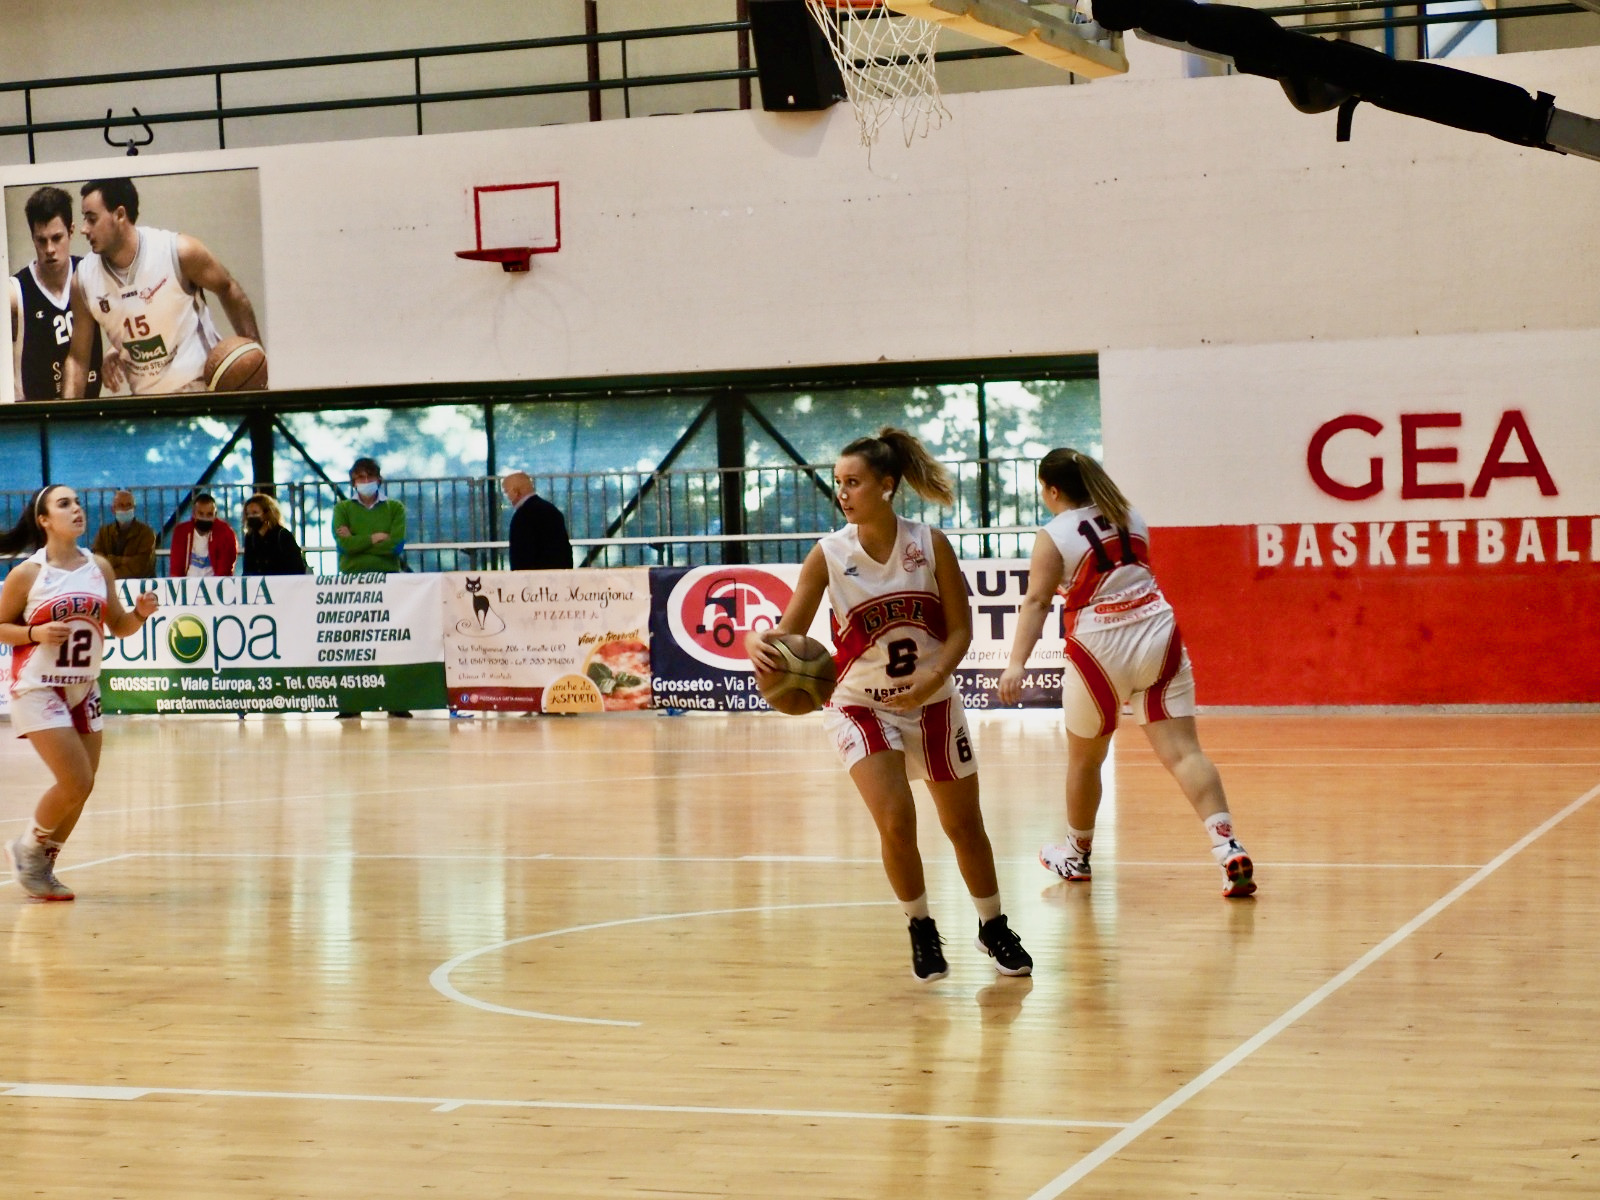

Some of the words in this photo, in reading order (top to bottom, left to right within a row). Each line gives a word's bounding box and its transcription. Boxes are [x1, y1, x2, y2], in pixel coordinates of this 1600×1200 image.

[123, 314, 150, 339] 15
[1306, 410, 1559, 501] GEA
[316, 572, 387, 586] ORTOPEDIA
[118, 576, 275, 607] ARMACIA
[316, 590, 383, 605] SANITARIA
[497, 587, 515, 603] La
[521, 586, 559, 603] Gatta
[564, 586, 634, 609] Mangiona
[52, 596, 102, 622] GEA
[316, 609, 390, 624] OMEOPATIA
[533, 610, 600, 621] PIZZERIA
[863, 598, 926, 634] GEA
[317, 628, 411, 643] ERBORISTERIA
[56, 628, 93, 668] 12
[318, 648, 376, 662] COSMESI
[885, 637, 918, 679] 6
[978, 651, 996, 662] per
[41, 674, 94, 685] BASKETBA
[110, 676, 170, 692] GROSSETO
[181, 676, 209, 692] Viale
[212, 675, 256, 693] Europa,
[258, 676, 273, 691] 33
[284, 675, 305, 690] Tel.
[307, 675, 337, 690] 0564
[340, 674, 386, 689] 451894
[579, 679, 591, 691] da
[652, 676, 714, 692] Grosseto
[724, 676, 744, 691] Via
[748, 676, 761, 691] Pa
[975, 674, 999, 689] Fax
[156, 694, 338, 712] parafarmaciaeuropa@virgilio.it
[551, 692, 597, 705] ASPORTO
[654, 694, 715, 709] Follonica
[725, 694, 746, 709] Via
[956, 736, 972, 764] 6
